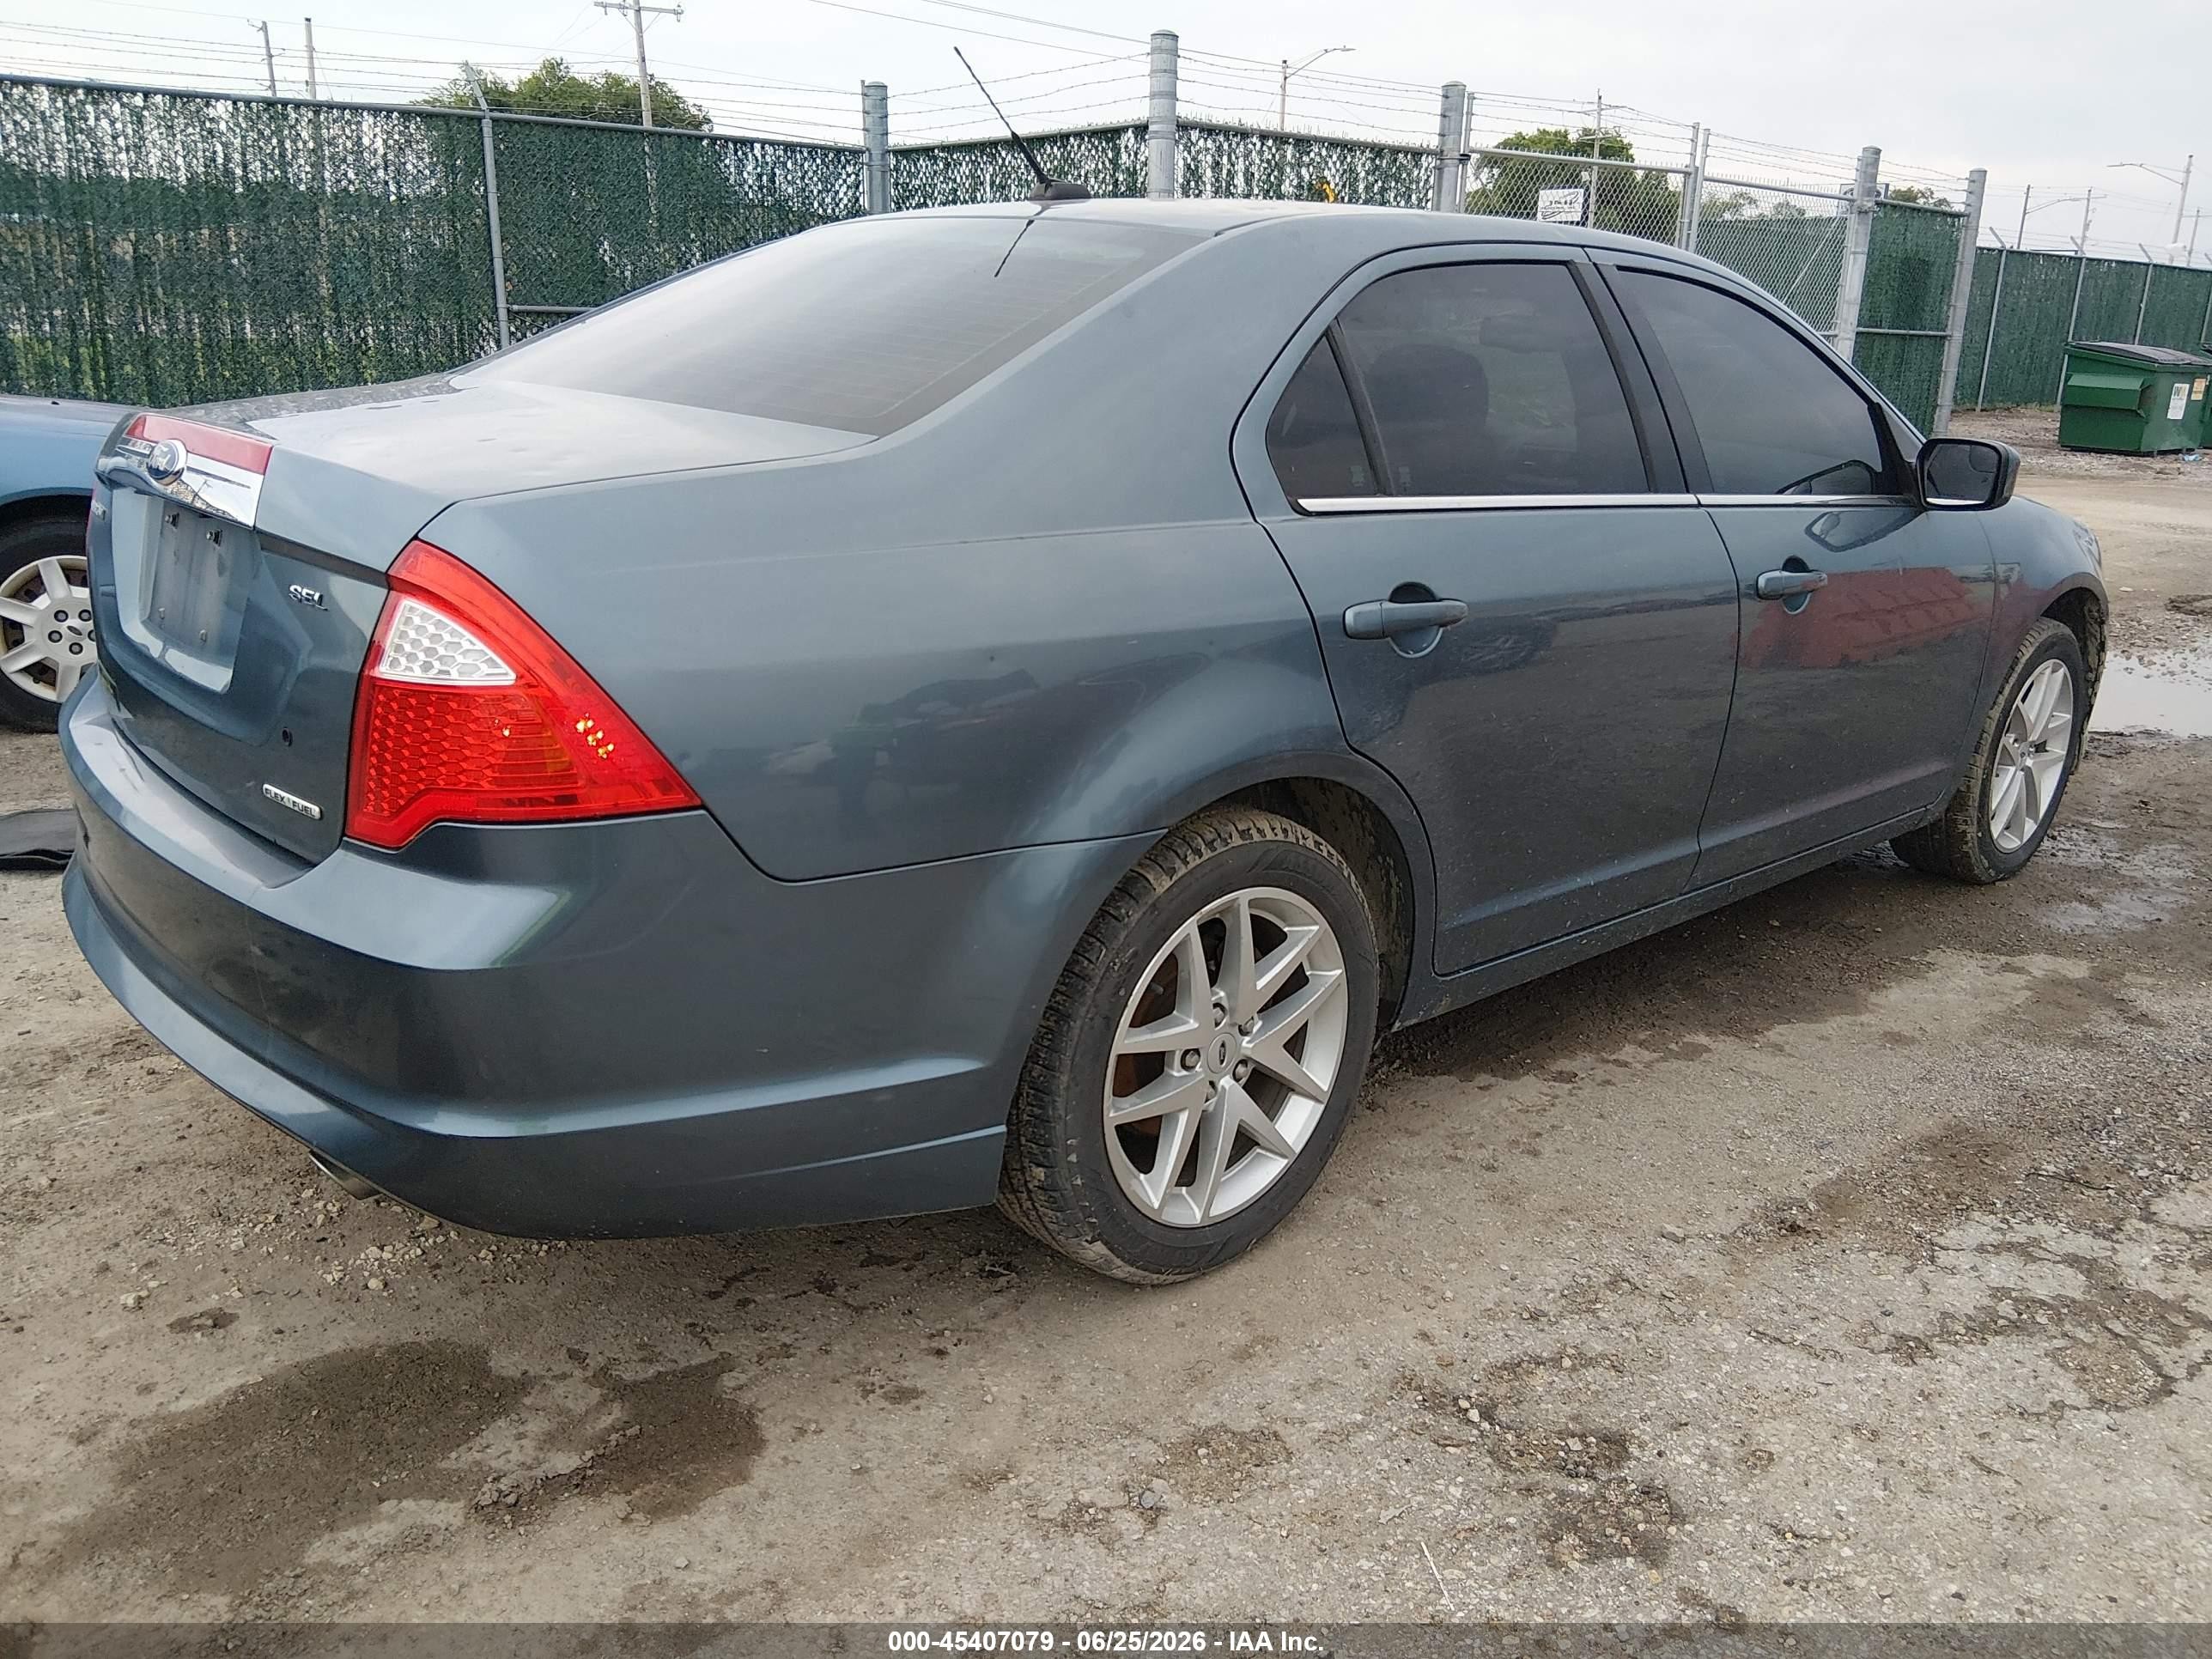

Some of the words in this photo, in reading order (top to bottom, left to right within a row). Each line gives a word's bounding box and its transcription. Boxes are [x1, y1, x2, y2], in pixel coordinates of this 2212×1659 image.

[289, 585, 328, 611] SEL
[264, 787, 286, 804] FLEX
[292, 800, 316, 817] FUEL
